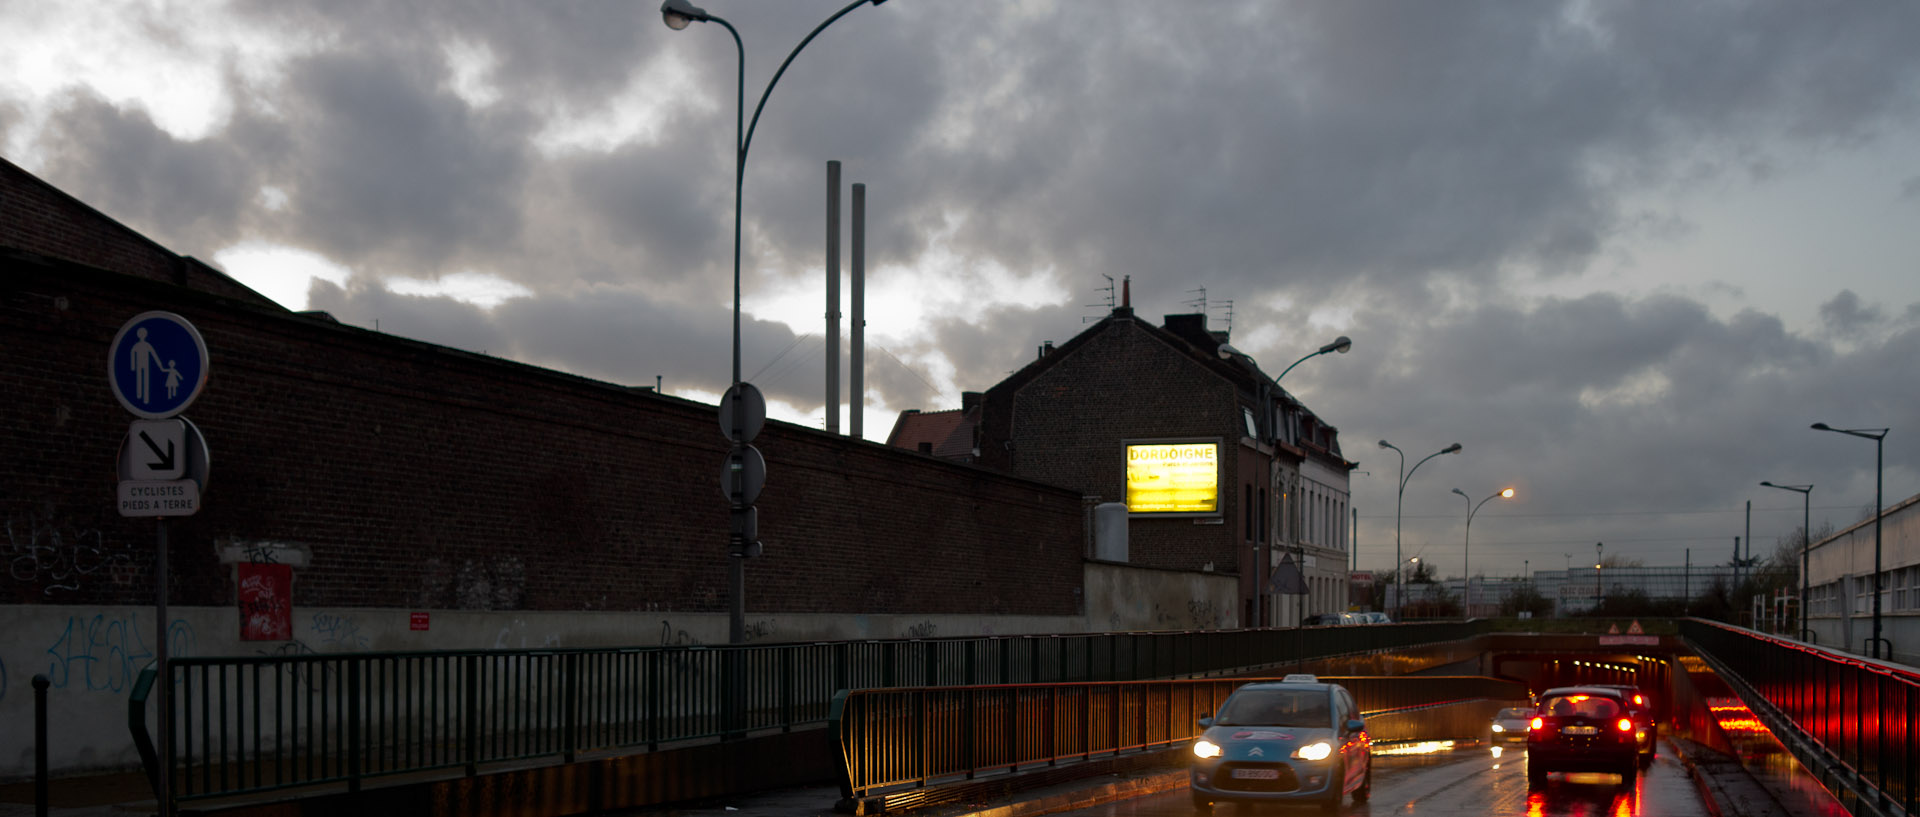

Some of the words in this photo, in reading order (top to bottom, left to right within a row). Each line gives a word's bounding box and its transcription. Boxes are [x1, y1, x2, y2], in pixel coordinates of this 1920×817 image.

[130, 486, 184, 496] CYCLISTES
[122, 500, 150, 510] PIEDS
[153, 500, 160, 509] A
[163, 499, 193, 509] TERRE
[1351, 573, 1371, 581] HOTEL
